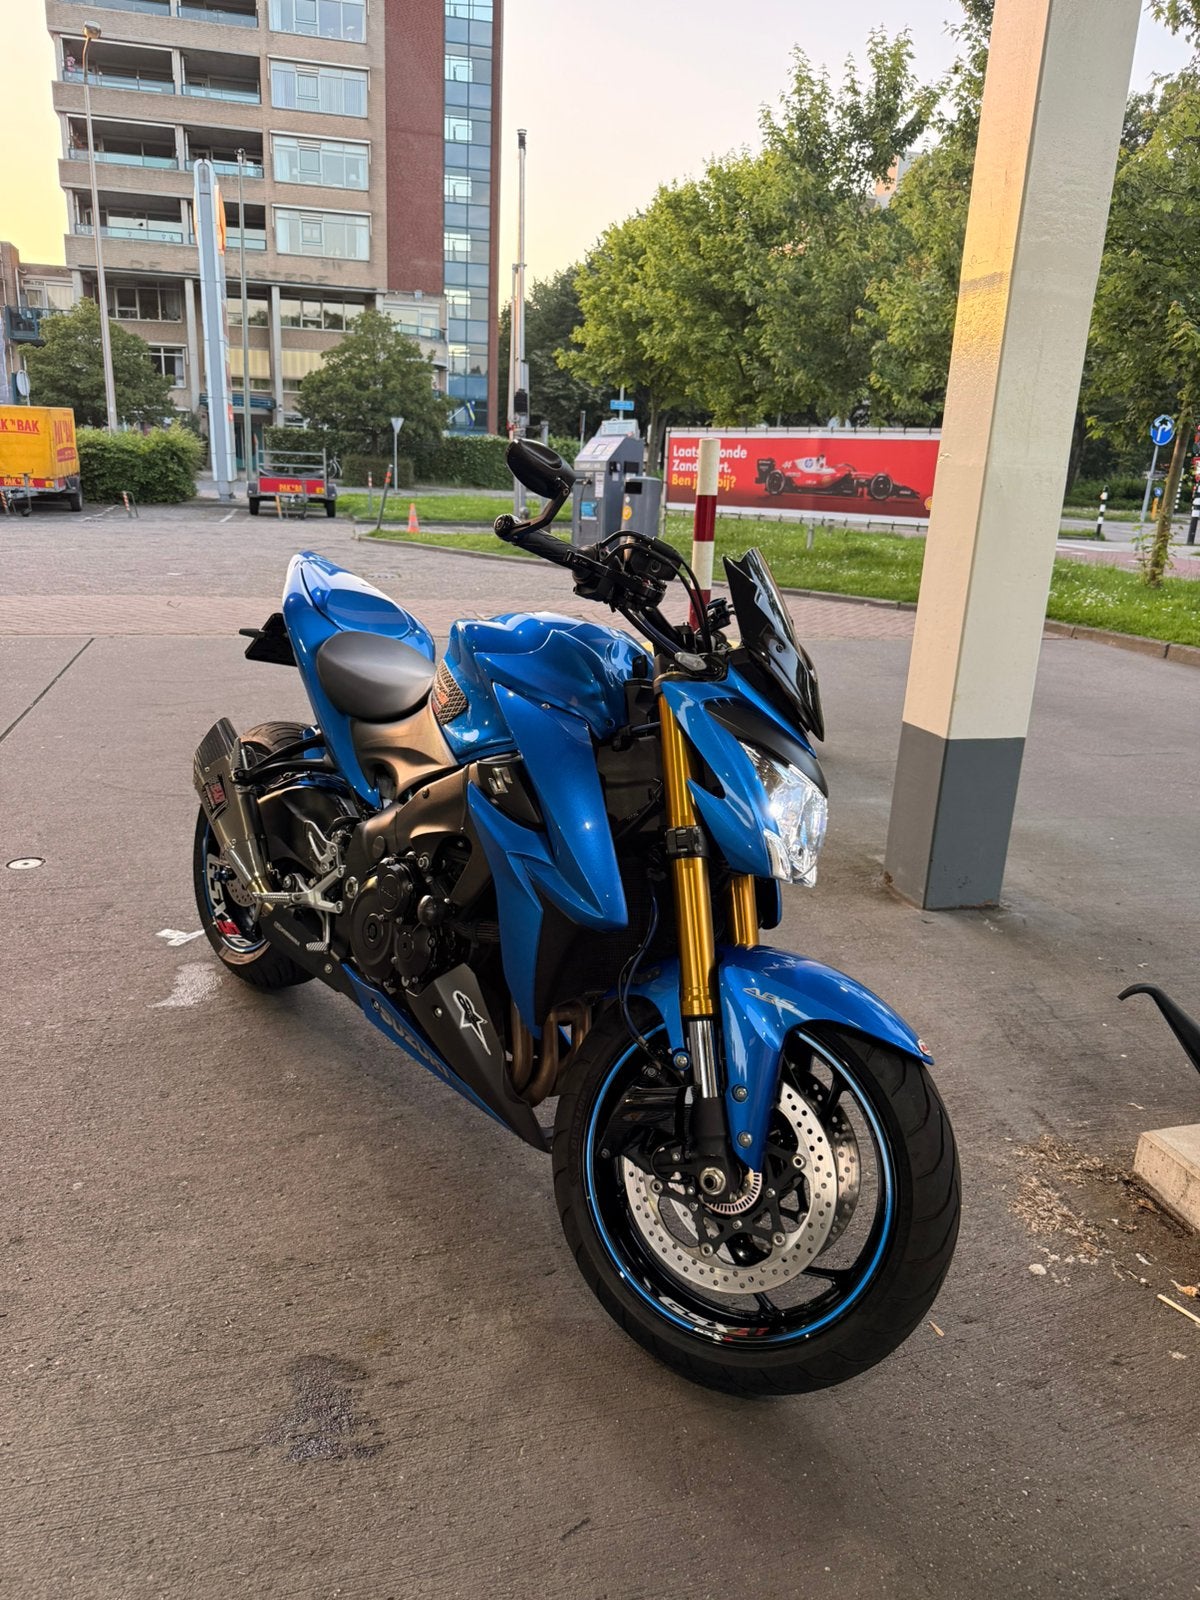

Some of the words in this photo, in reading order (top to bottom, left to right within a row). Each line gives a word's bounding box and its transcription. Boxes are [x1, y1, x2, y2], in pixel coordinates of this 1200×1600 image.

[17, 419, 40, 433] BAK
[719, 444, 748, 459] onde
[671, 474, 692, 486] Ben
